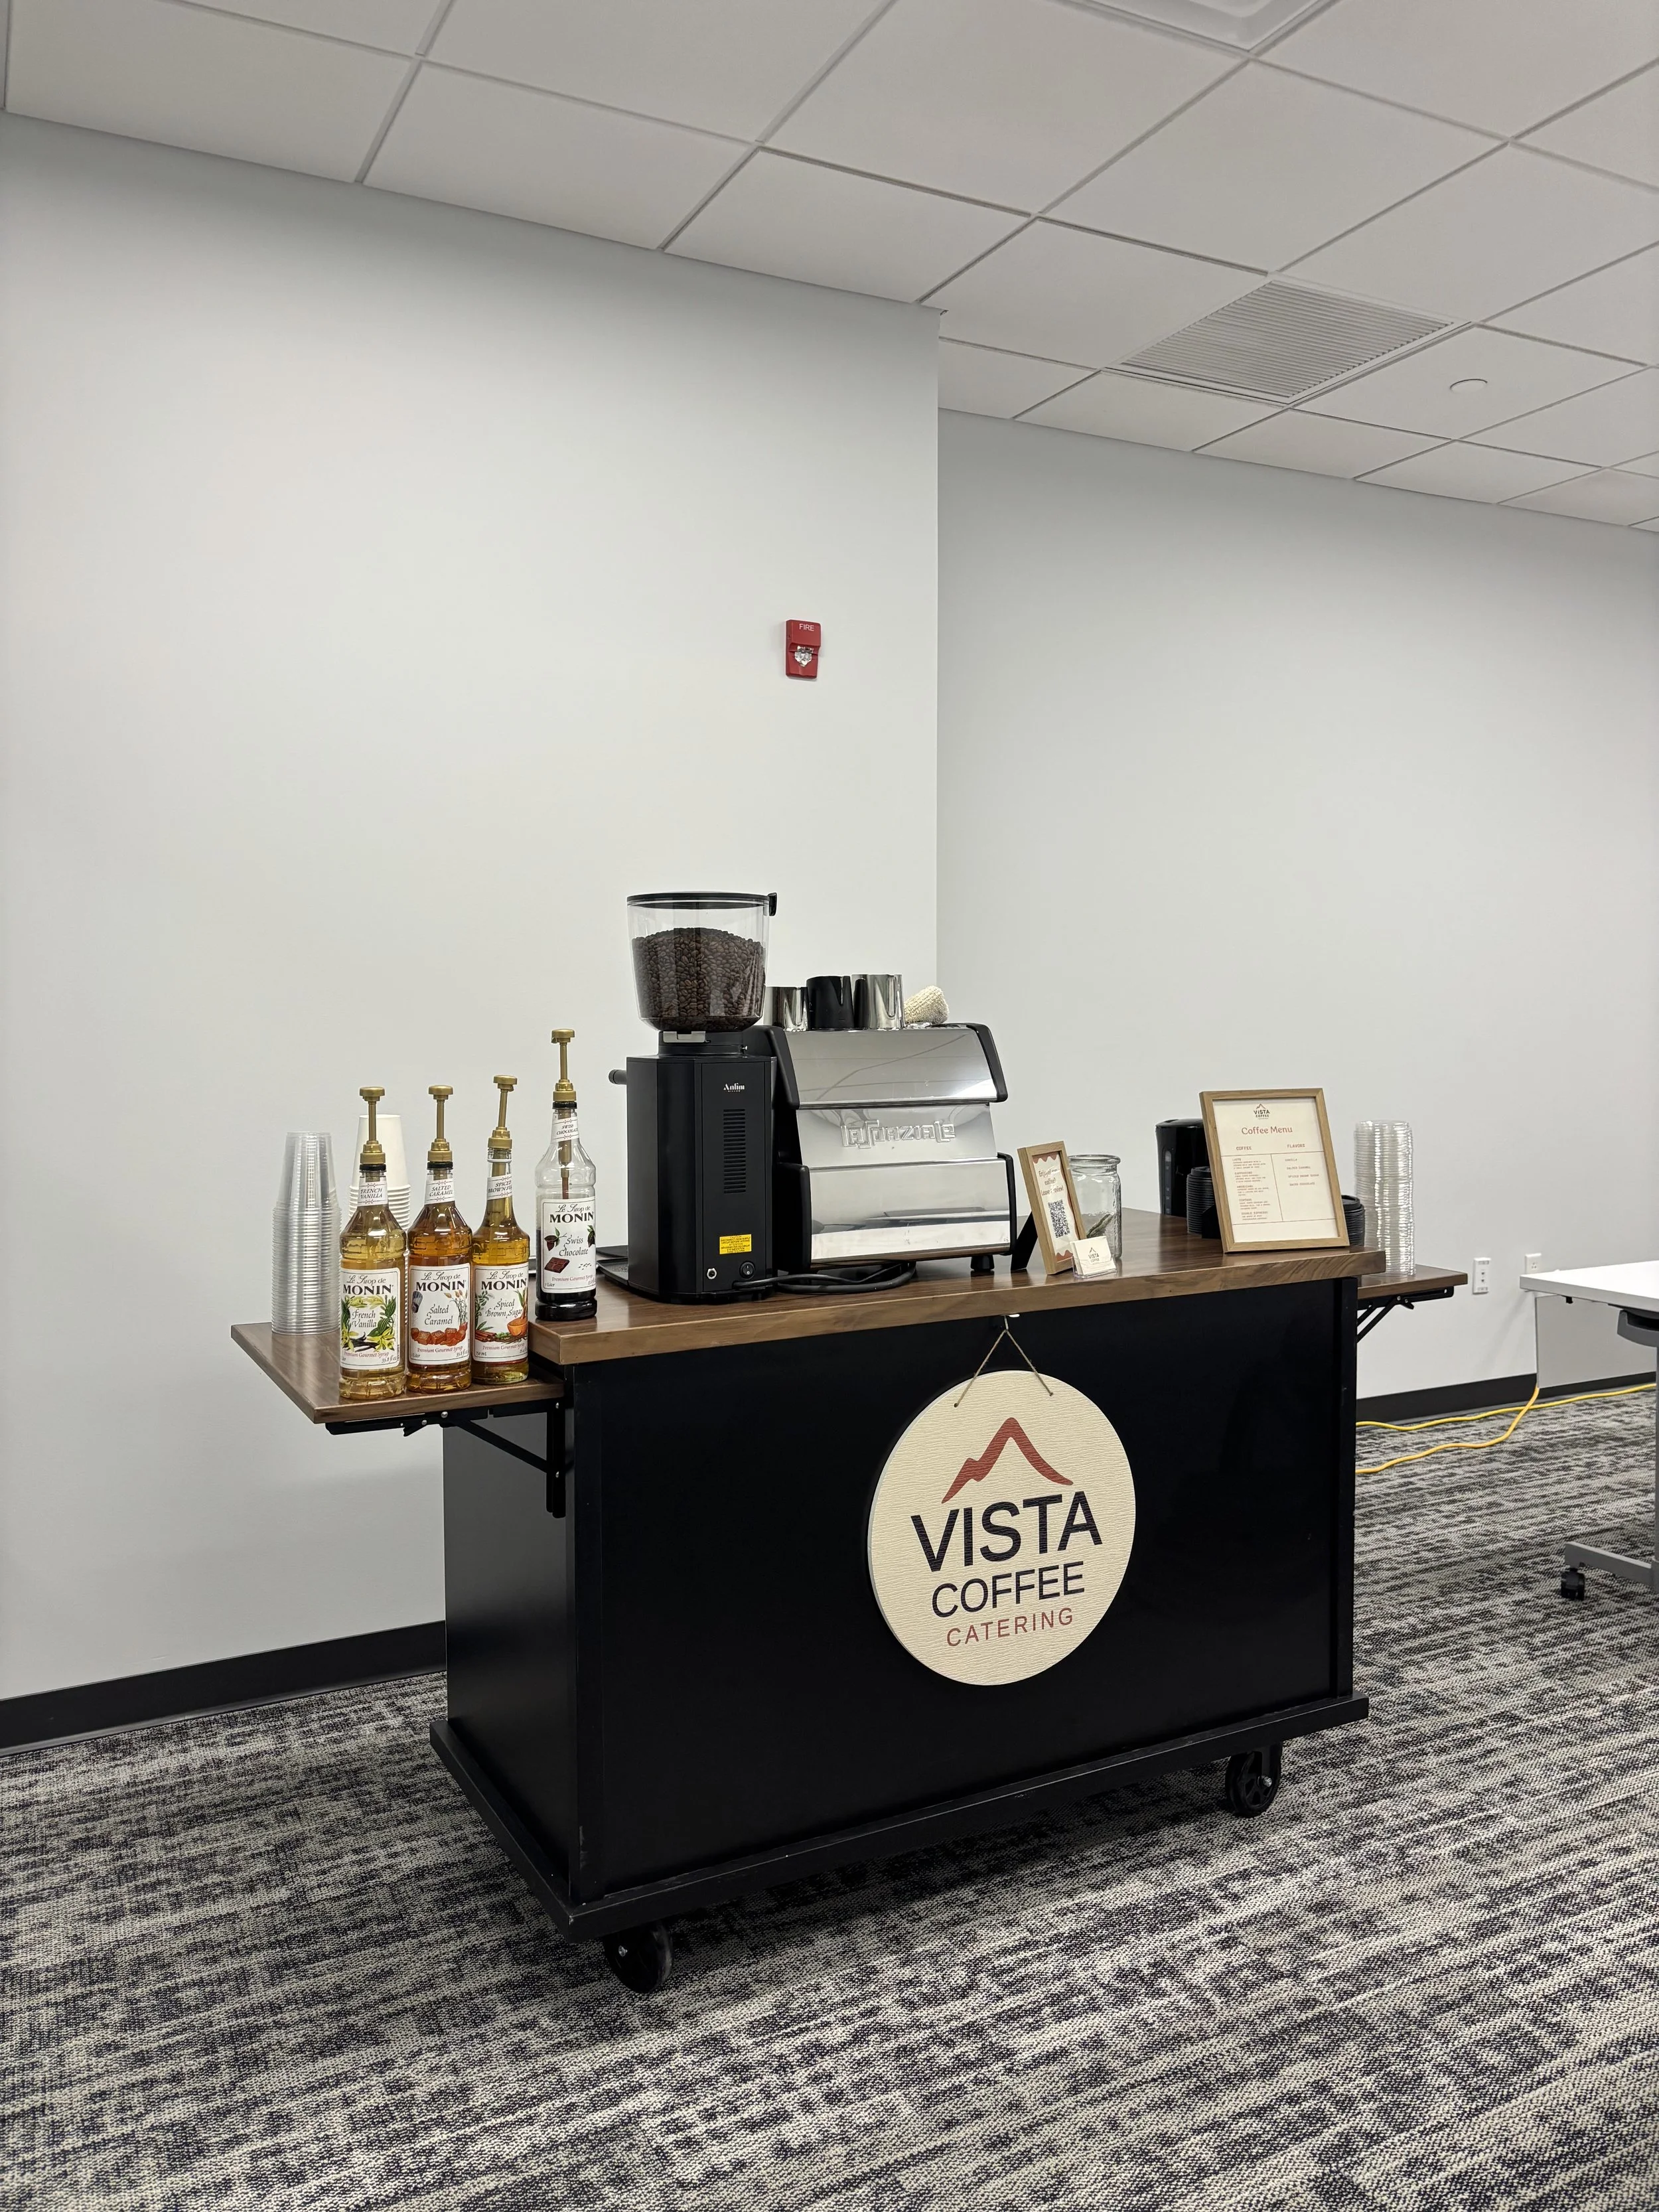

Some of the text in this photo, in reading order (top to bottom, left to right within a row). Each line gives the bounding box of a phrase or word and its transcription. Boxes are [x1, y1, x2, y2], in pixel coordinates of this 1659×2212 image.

[1242, 1126, 1268, 1135] Coffee
[567, 1204, 585, 1213] Sirop
[549, 1212, 593, 1223] MONIN
[563, 1234, 583, 1245] Swiss
[559, 1246, 589, 1256] Chocolate
[346, 1275, 356, 1284] Le
[357, 1275, 376, 1286] Sirop
[421, 1272, 432, 1280] Le
[433, 1272, 453, 1282] Sirop
[499, 1270, 517, 1280] Sirop
[343, 1284, 392, 1295] MONIN
[416, 1280, 465, 1291] MONIN
[481, 1278, 526, 1290] MONIN
[427, 1304, 449, 1316] Salted
[494, 1299, 515, 1310] Spiced
[352, 1309, 376, 1319] French
[485, 1307, 522, 1318] Brown Sugar
[351, 1319, 377, 1328] Vanilla
[425, 1315, 453, 1325] Caramel
[910, 1491, 1103, 1572] VISTA
[932, 1561, 1084, 1618] COFFEE
[946, 1607, 1073, 1647] CATERING
